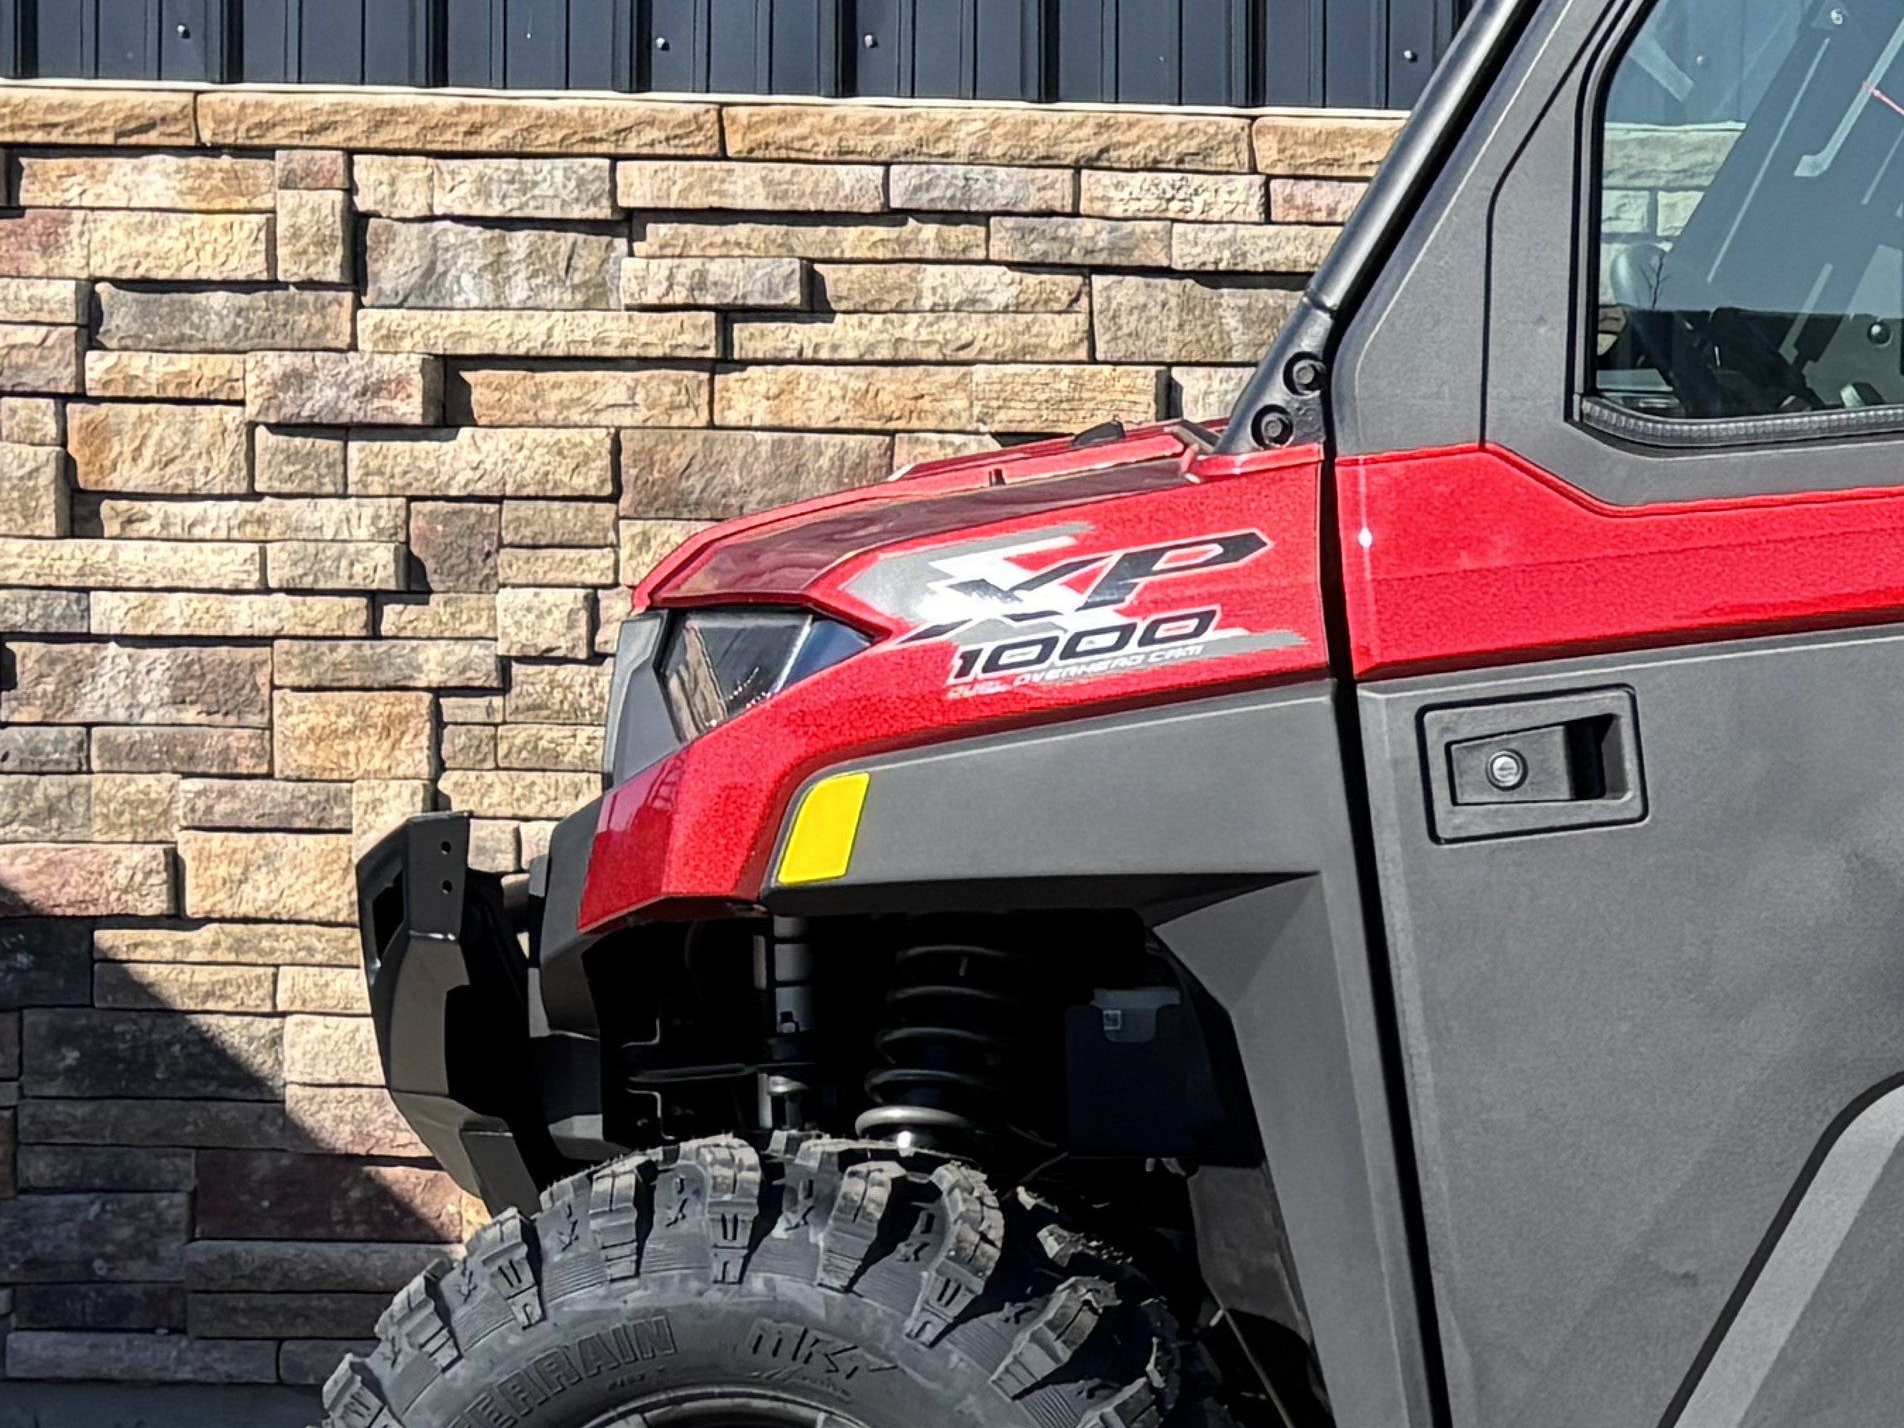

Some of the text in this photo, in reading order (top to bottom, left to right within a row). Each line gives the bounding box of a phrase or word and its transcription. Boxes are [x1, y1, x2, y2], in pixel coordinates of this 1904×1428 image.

[898, 530, 1272, 644] XP
[952, 608, 1219, 680] 1000
[1013, 654, 1145, 687] OVERHEAD
[1147, 645, 1205, 663] CAM
